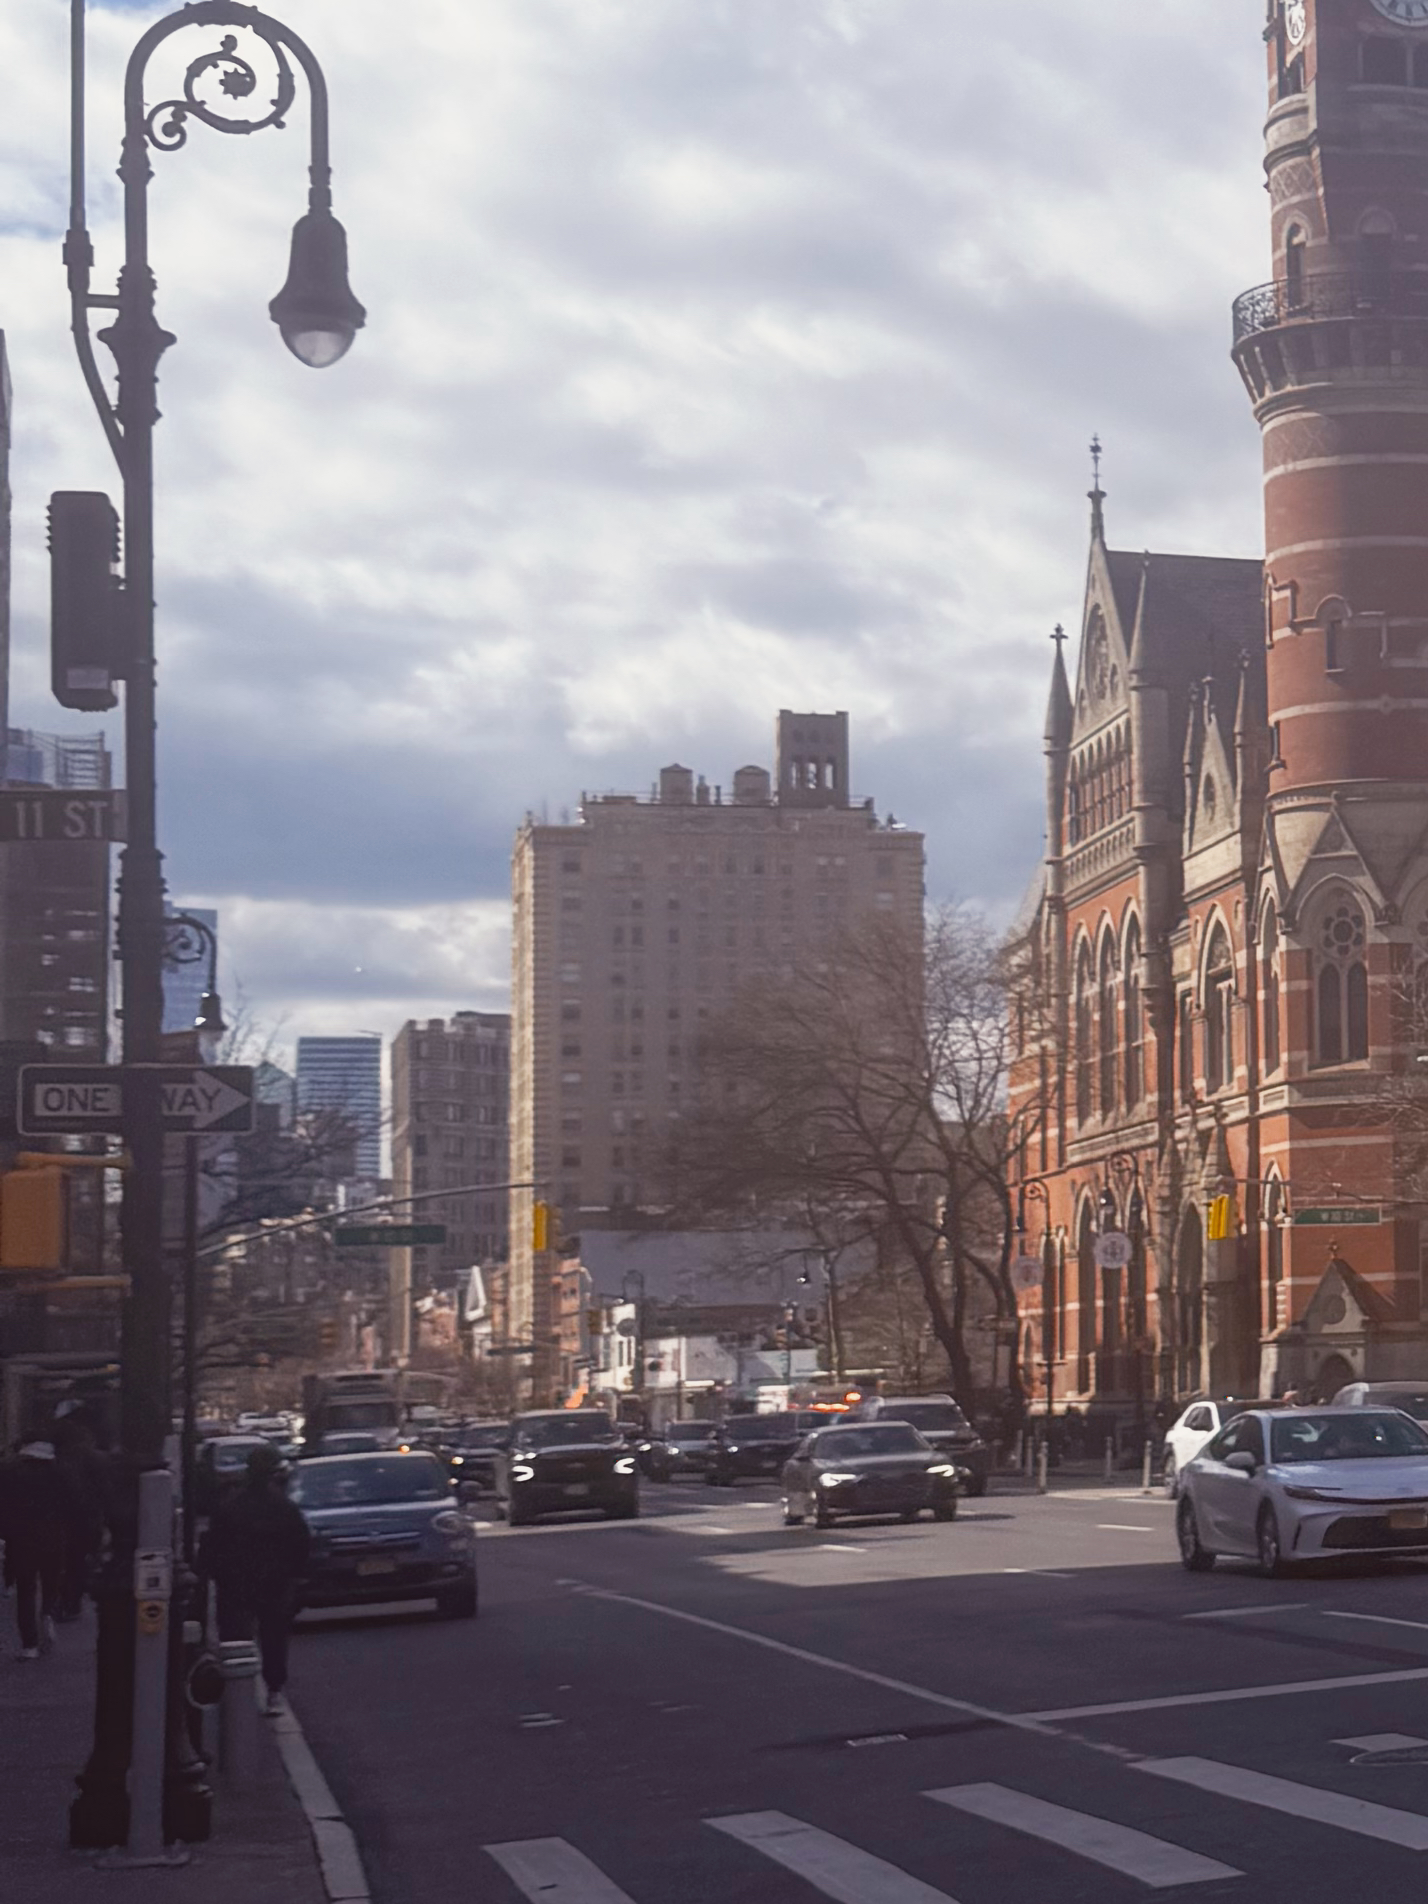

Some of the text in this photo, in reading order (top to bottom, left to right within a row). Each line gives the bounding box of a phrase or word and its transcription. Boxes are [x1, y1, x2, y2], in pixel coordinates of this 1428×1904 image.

[15, 800, 108, 838] 11 ST
[42, 1087, 109, 1113] ONE
